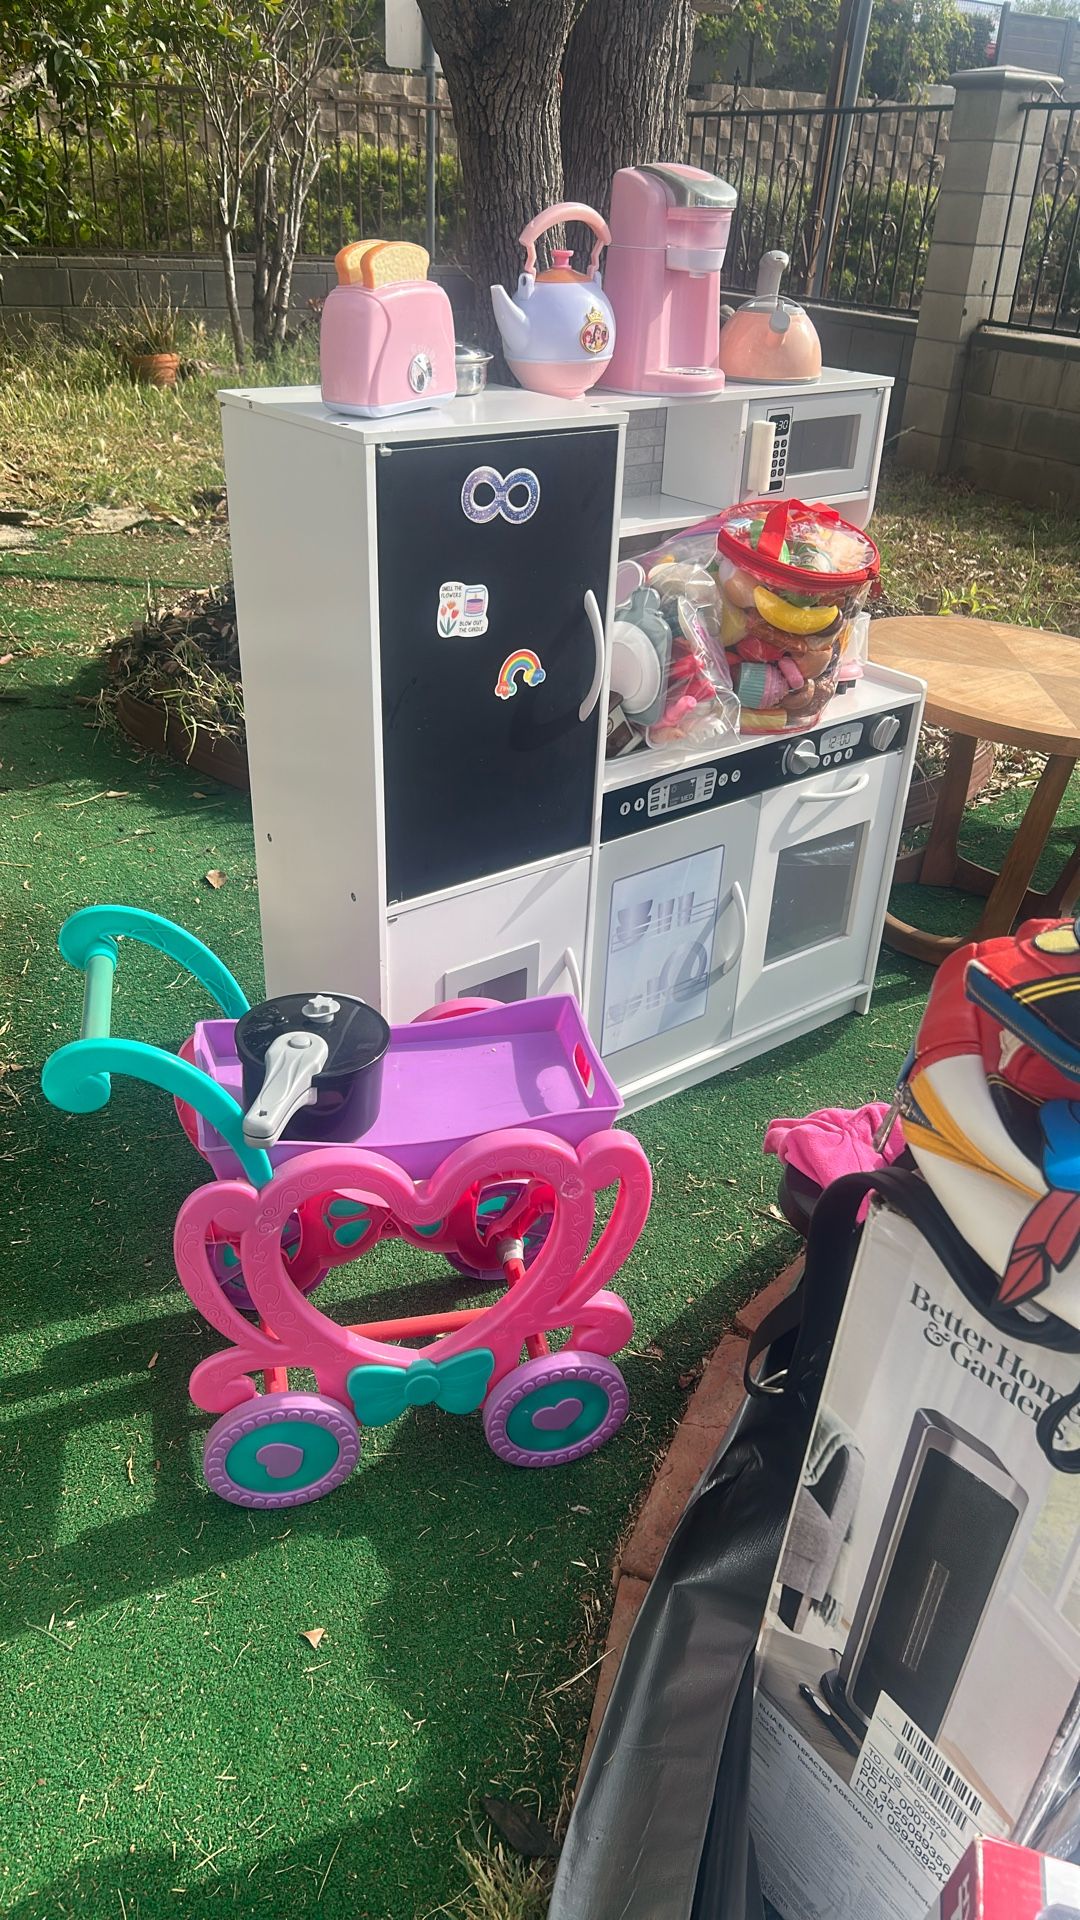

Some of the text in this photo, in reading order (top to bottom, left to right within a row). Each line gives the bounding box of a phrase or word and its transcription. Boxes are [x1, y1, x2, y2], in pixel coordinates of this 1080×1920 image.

[829, 732, 851, 749] 12:00
[910, 1281, 993, 1354] Better
[923, 1321, 951, 1347] &
[862, 1757, 895, 1794] DEPT
[899, 1798, 935, 1840] 00011
[886, 1767, 902, 1789] US
[856, 1778, 885, 1813] ITEM
[886, 1813, 948, 1885] 05949824
[859, 1767, 877, 1789] PO
[880, 1791, 952, 1876] 3525089356
